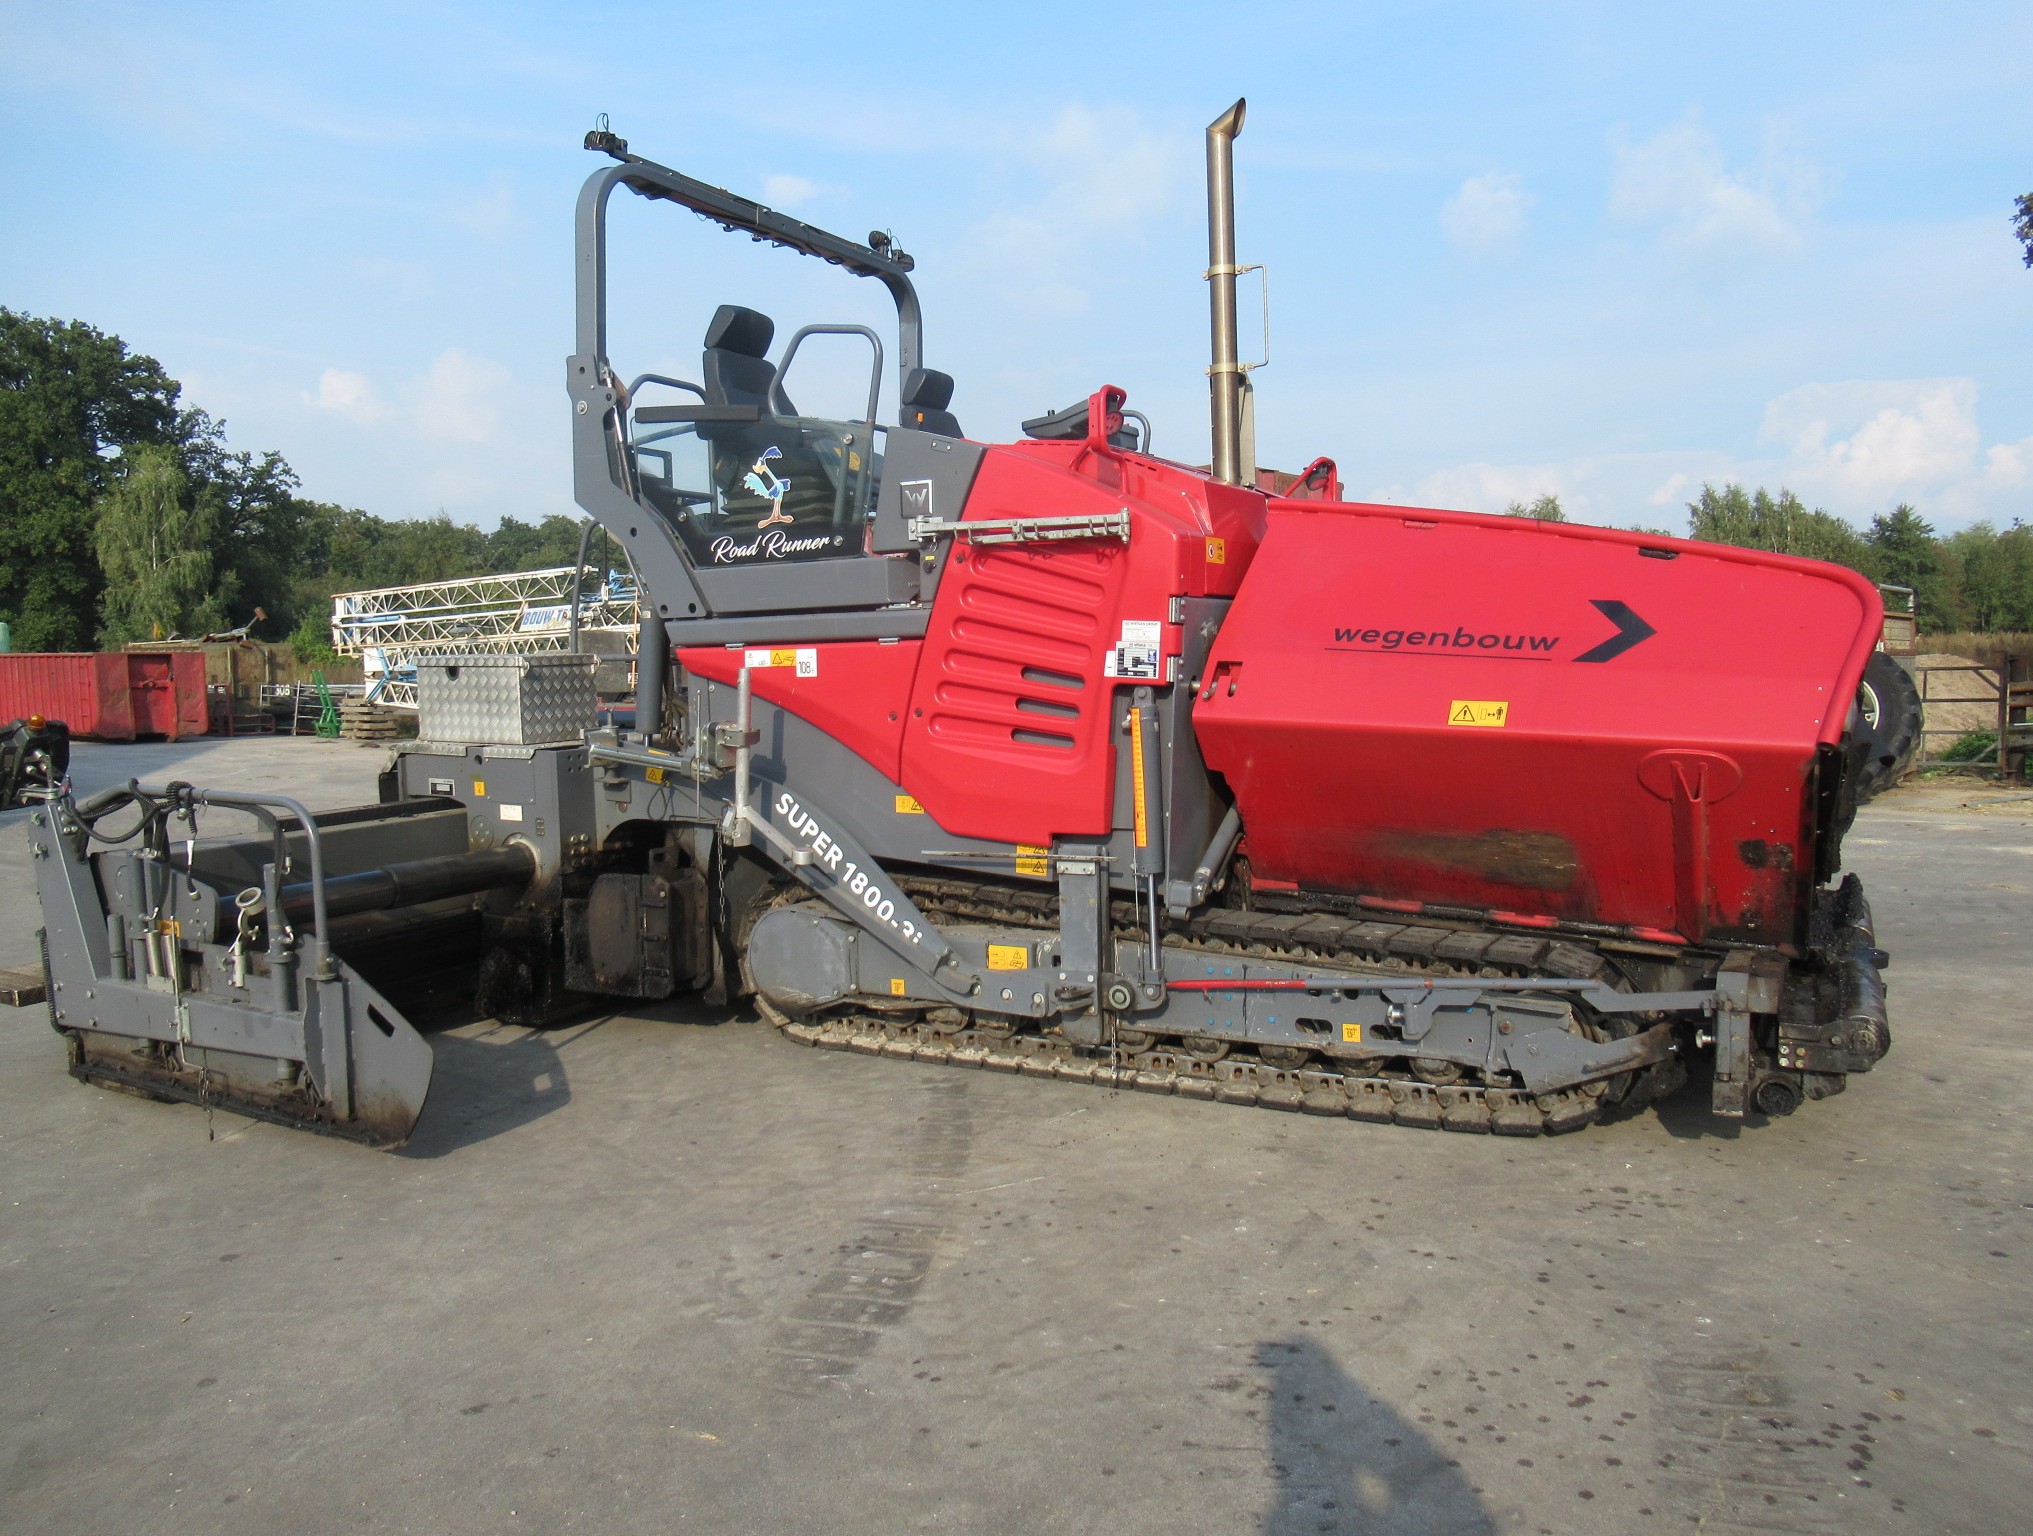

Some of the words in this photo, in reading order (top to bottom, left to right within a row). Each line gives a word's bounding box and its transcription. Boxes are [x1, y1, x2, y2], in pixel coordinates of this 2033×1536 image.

[711, 535, 762, 563] Road
[761, 530, 830, 558] Runner
[522, 610, 554, 626] BOUW
[1334, 626, 1560, 651] wegenbouw
[775, 793, 844, 870] SUPER
